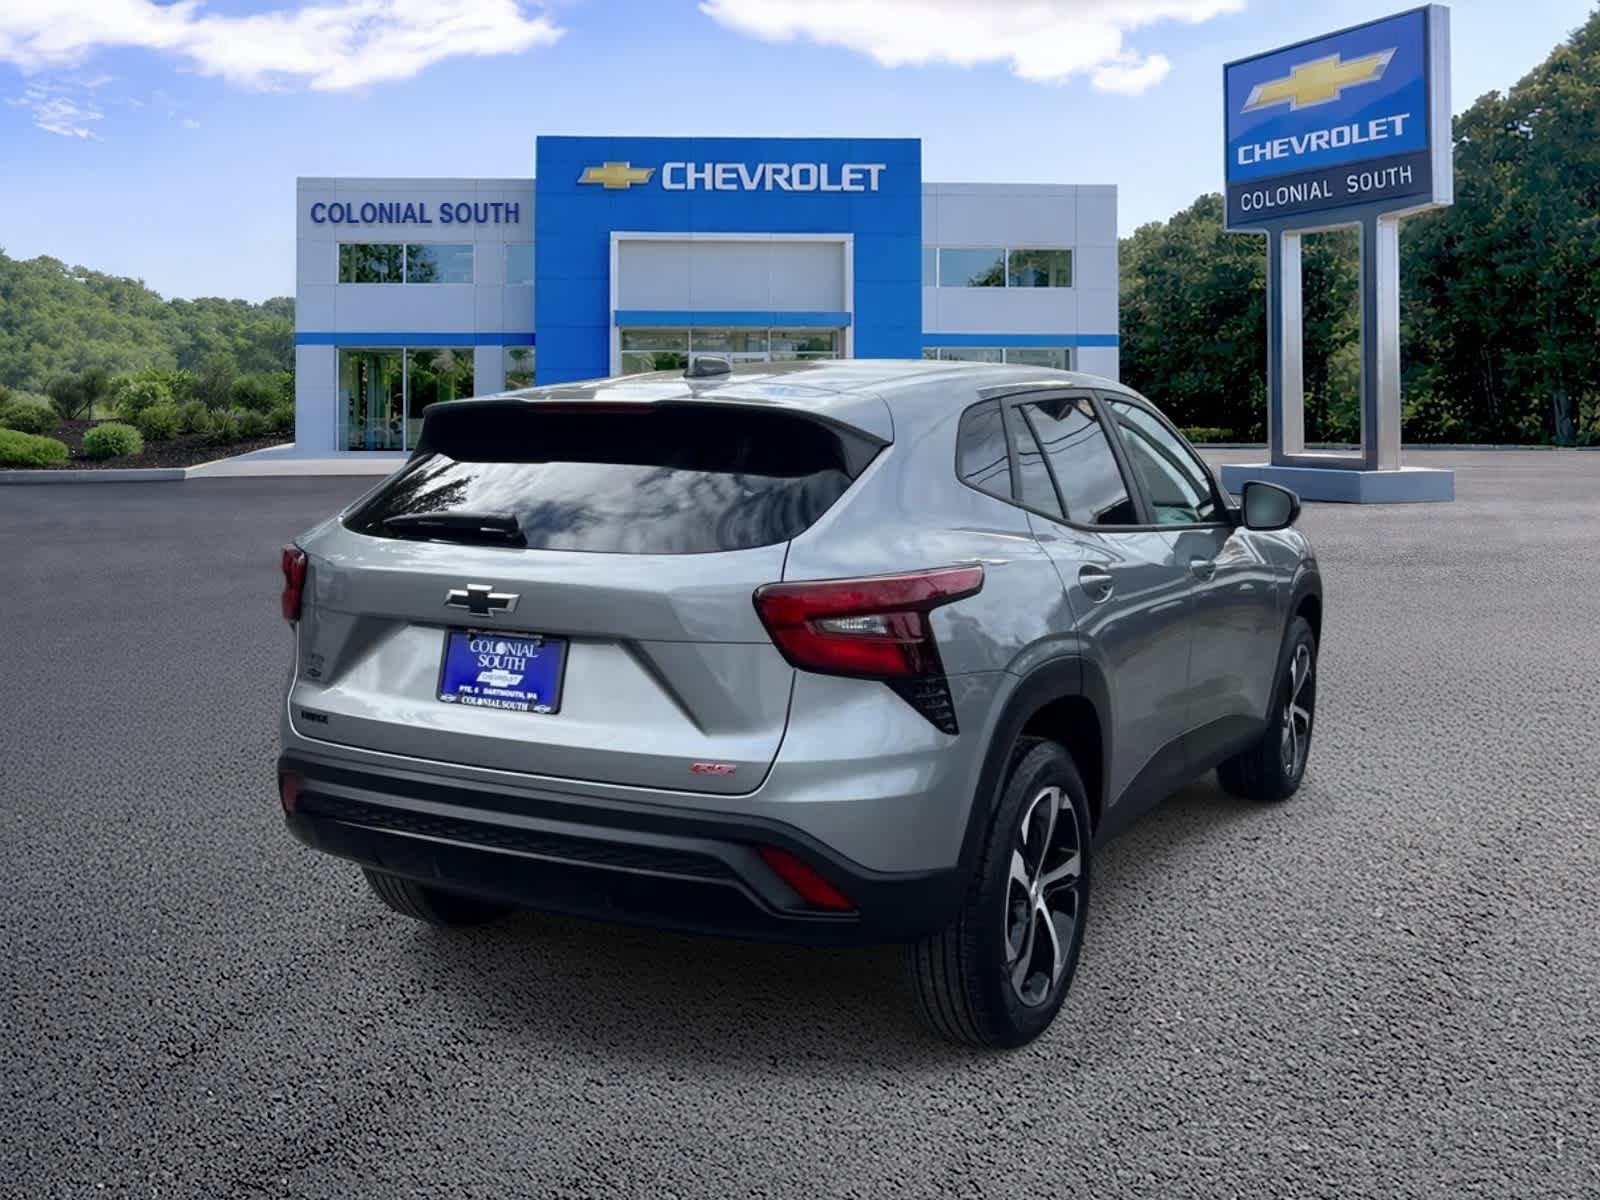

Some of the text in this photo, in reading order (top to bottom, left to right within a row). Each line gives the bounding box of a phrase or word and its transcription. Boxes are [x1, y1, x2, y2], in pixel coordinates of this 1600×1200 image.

[1238, 113, 1410, 165] CHEVROLET
[662, 162, 887, 192] CHEVROLET
[1241, 165, 1413, 211] COLONIAL SOUTH
[310, 202, 520, 224] COLONIAL SOUTH
[470, 640, 537, 657] COLONIAL
[478, 655, 525, 670] SOUTH
